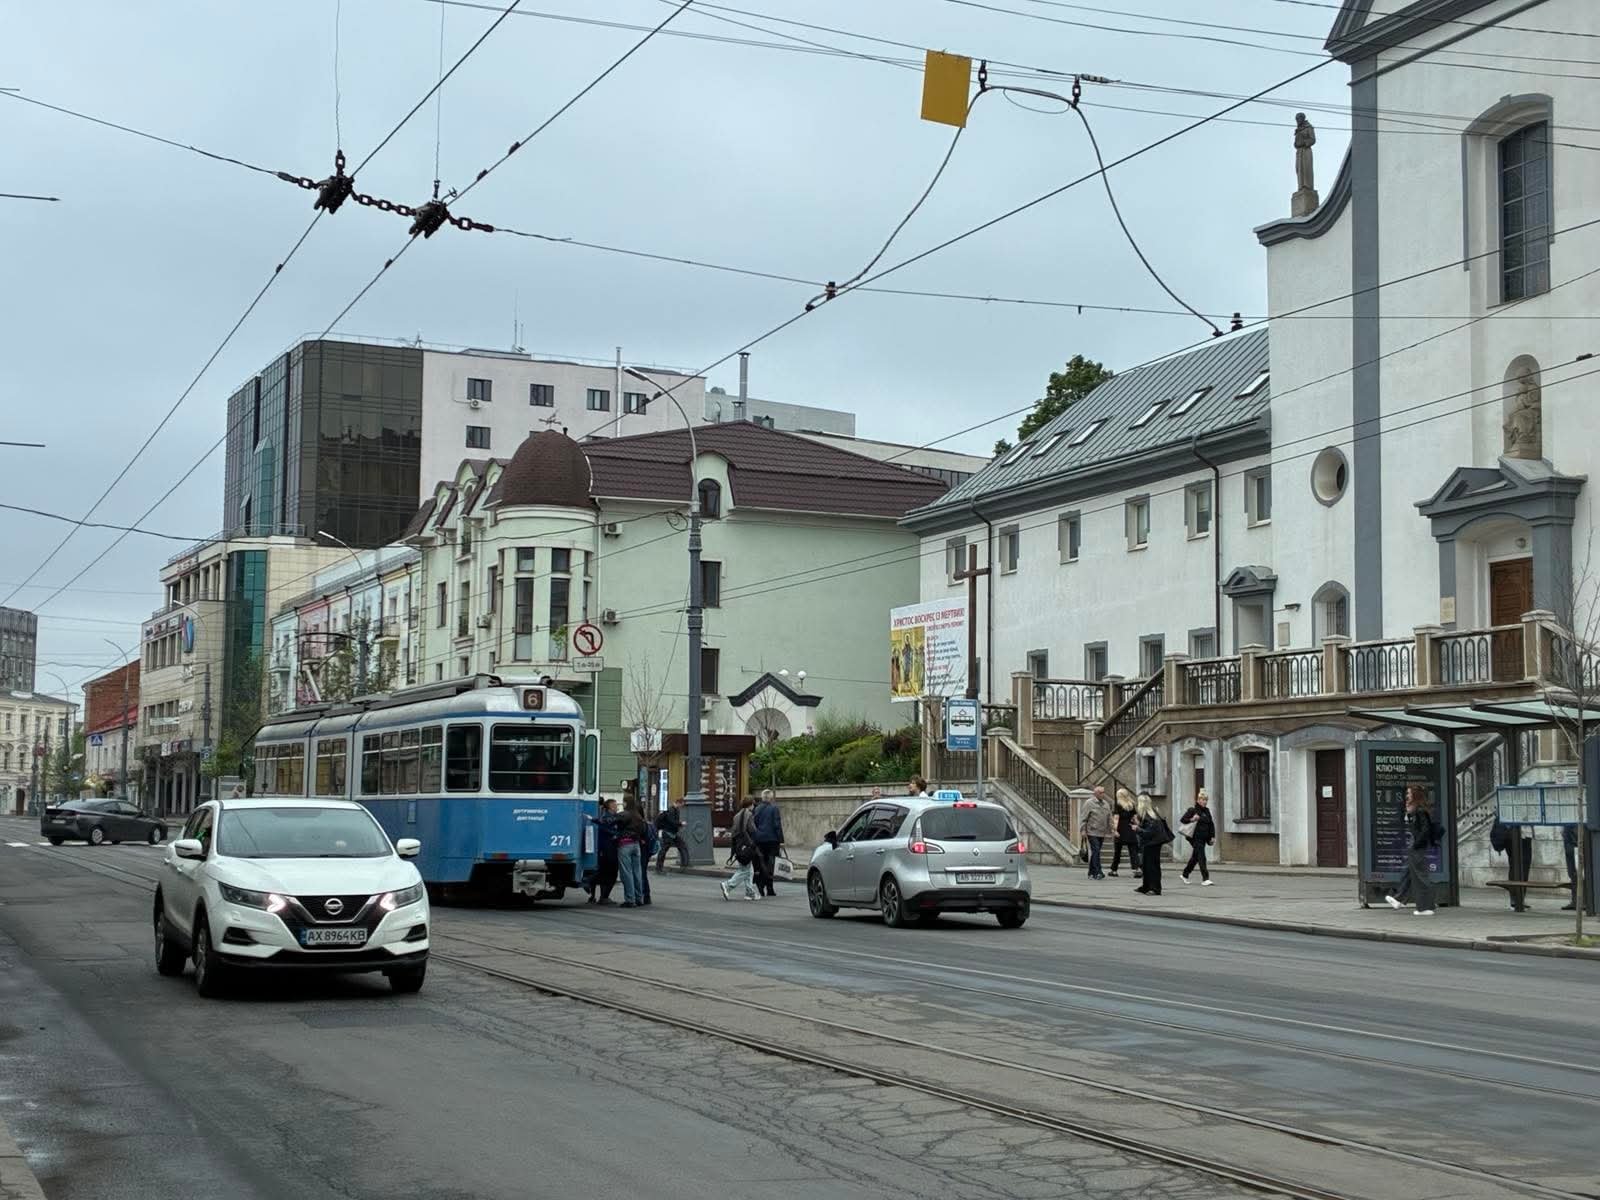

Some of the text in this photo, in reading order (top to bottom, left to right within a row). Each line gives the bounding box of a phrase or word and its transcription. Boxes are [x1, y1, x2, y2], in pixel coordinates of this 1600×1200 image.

[894, 615, 914, 627] ХРИСТОС
[914, 611, 936, 624] ВОСКРЕС
[528, 693, 538, 706] 6
[1375, 755, 1434, 764] ВИГОТОВЛЕННЯ
[1375, 764, 1407, 772] КЛЮЧІВ
[550, 835, 571, 846] 271
[308, 930, 366, 941] AX 8964 KB
